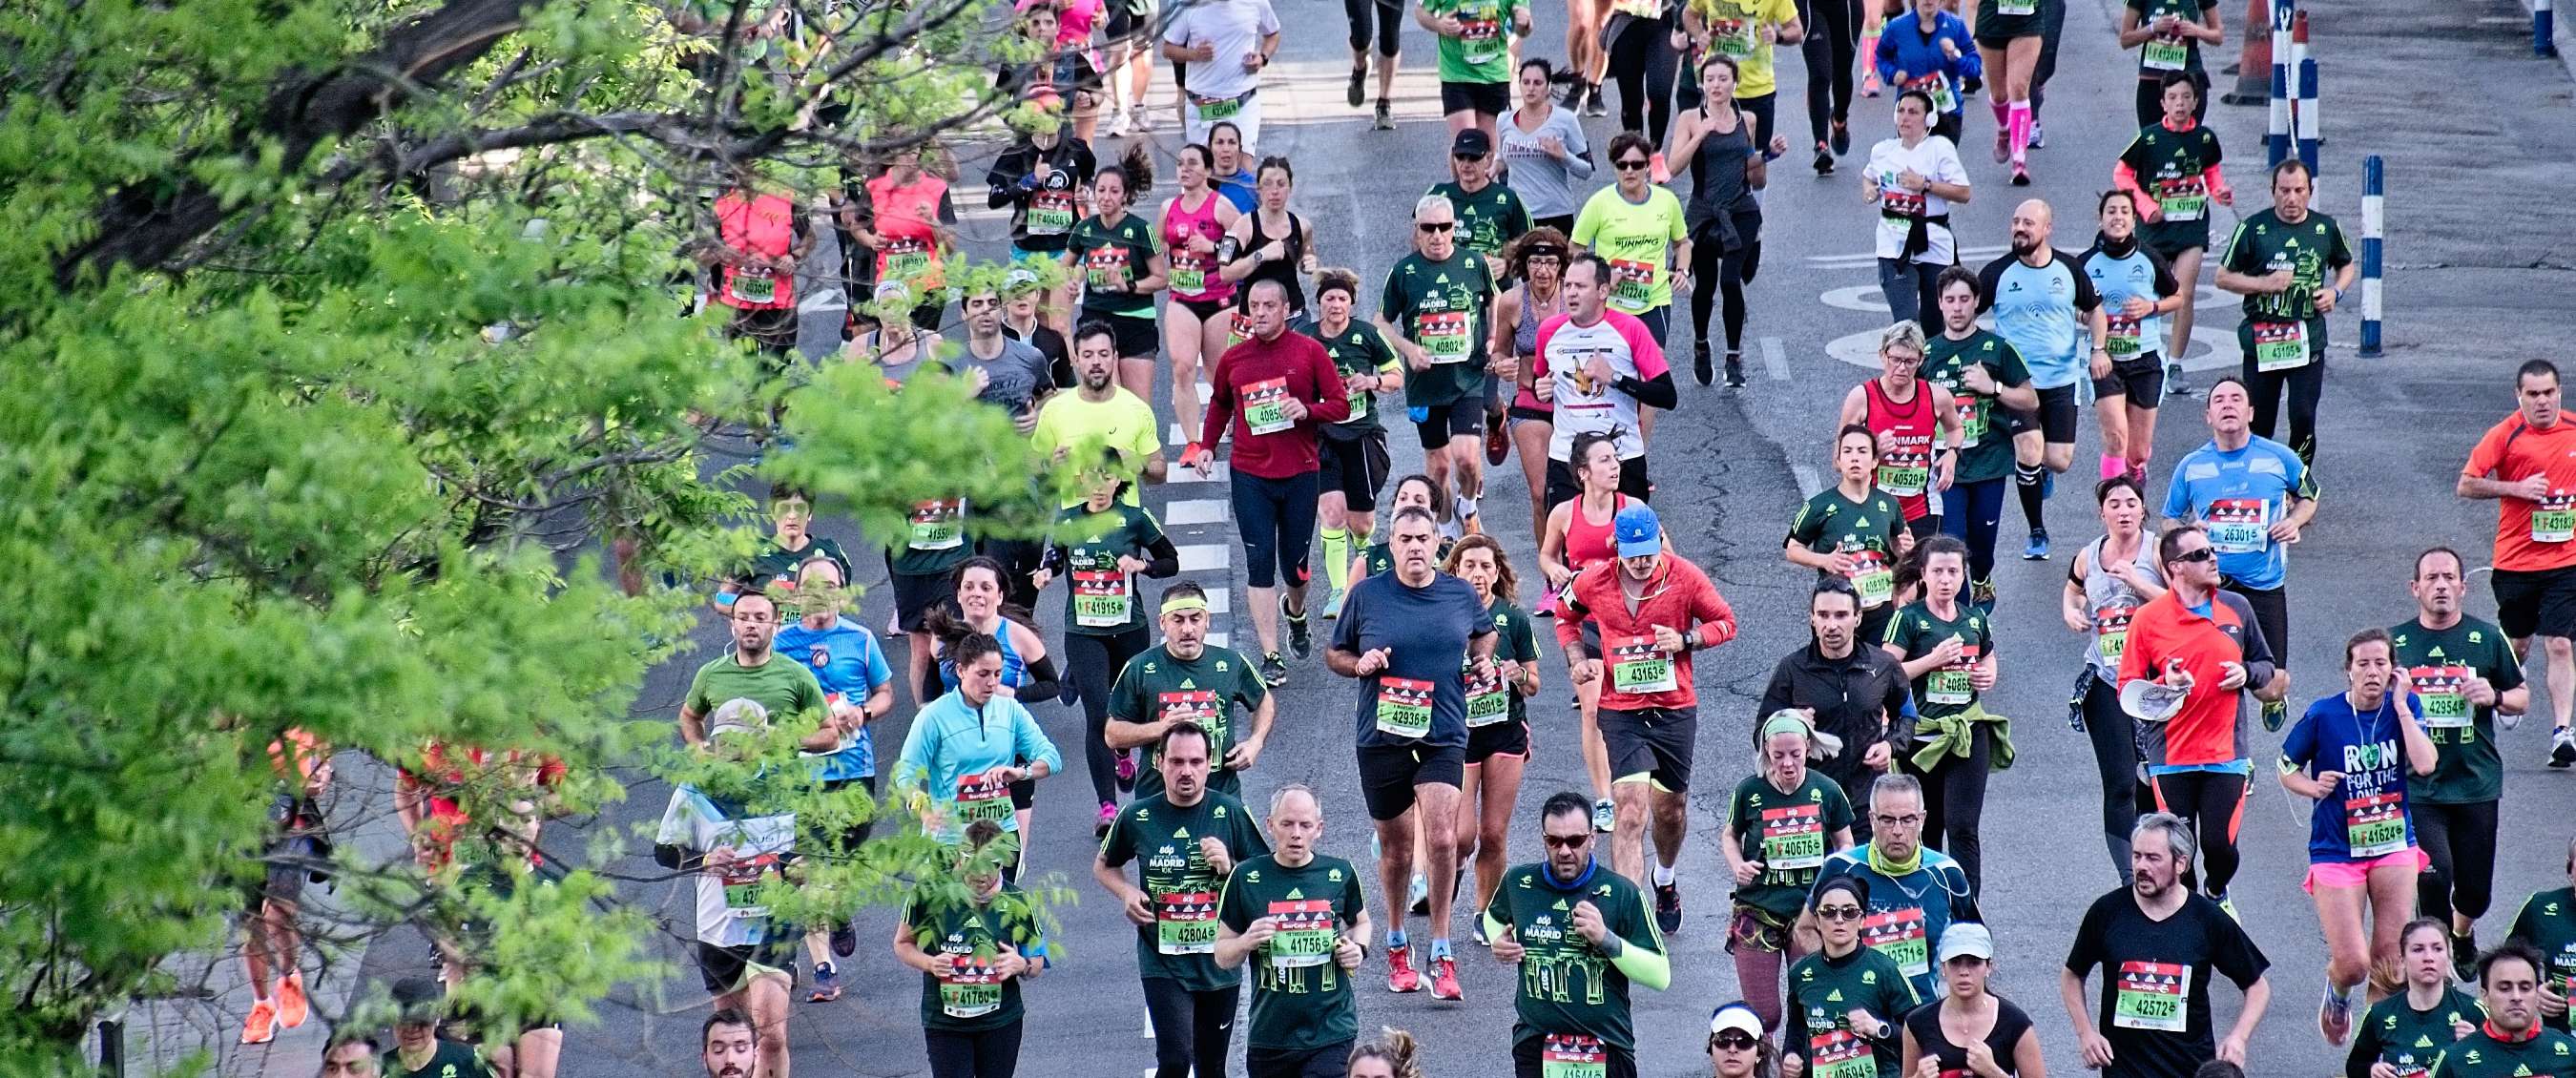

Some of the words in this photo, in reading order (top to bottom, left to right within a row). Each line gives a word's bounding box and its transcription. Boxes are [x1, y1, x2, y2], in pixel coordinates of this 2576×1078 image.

[1434, 340, 1459, 353] 40802
[2224, 528, 2251, 542] 26301
[1631, 666, 1658, 682] 43163
[1470, 700, 1496, 716] 40901
[2429, 698, 2458, 715] 42954
[1392, 709, 1421, 727] 42936
[2345, 773, 2375, 791] FOR
[2377, 767, 2398, 786] THE
[1149, 858, 1186, 868] MADRID
[1177, 926, 1208, 943] 42804
[1524, 927, 1562, 940] MADRID
[1291, 938, 1321, 953] 41756
[2135, 998, 2168, 1017] 42572
